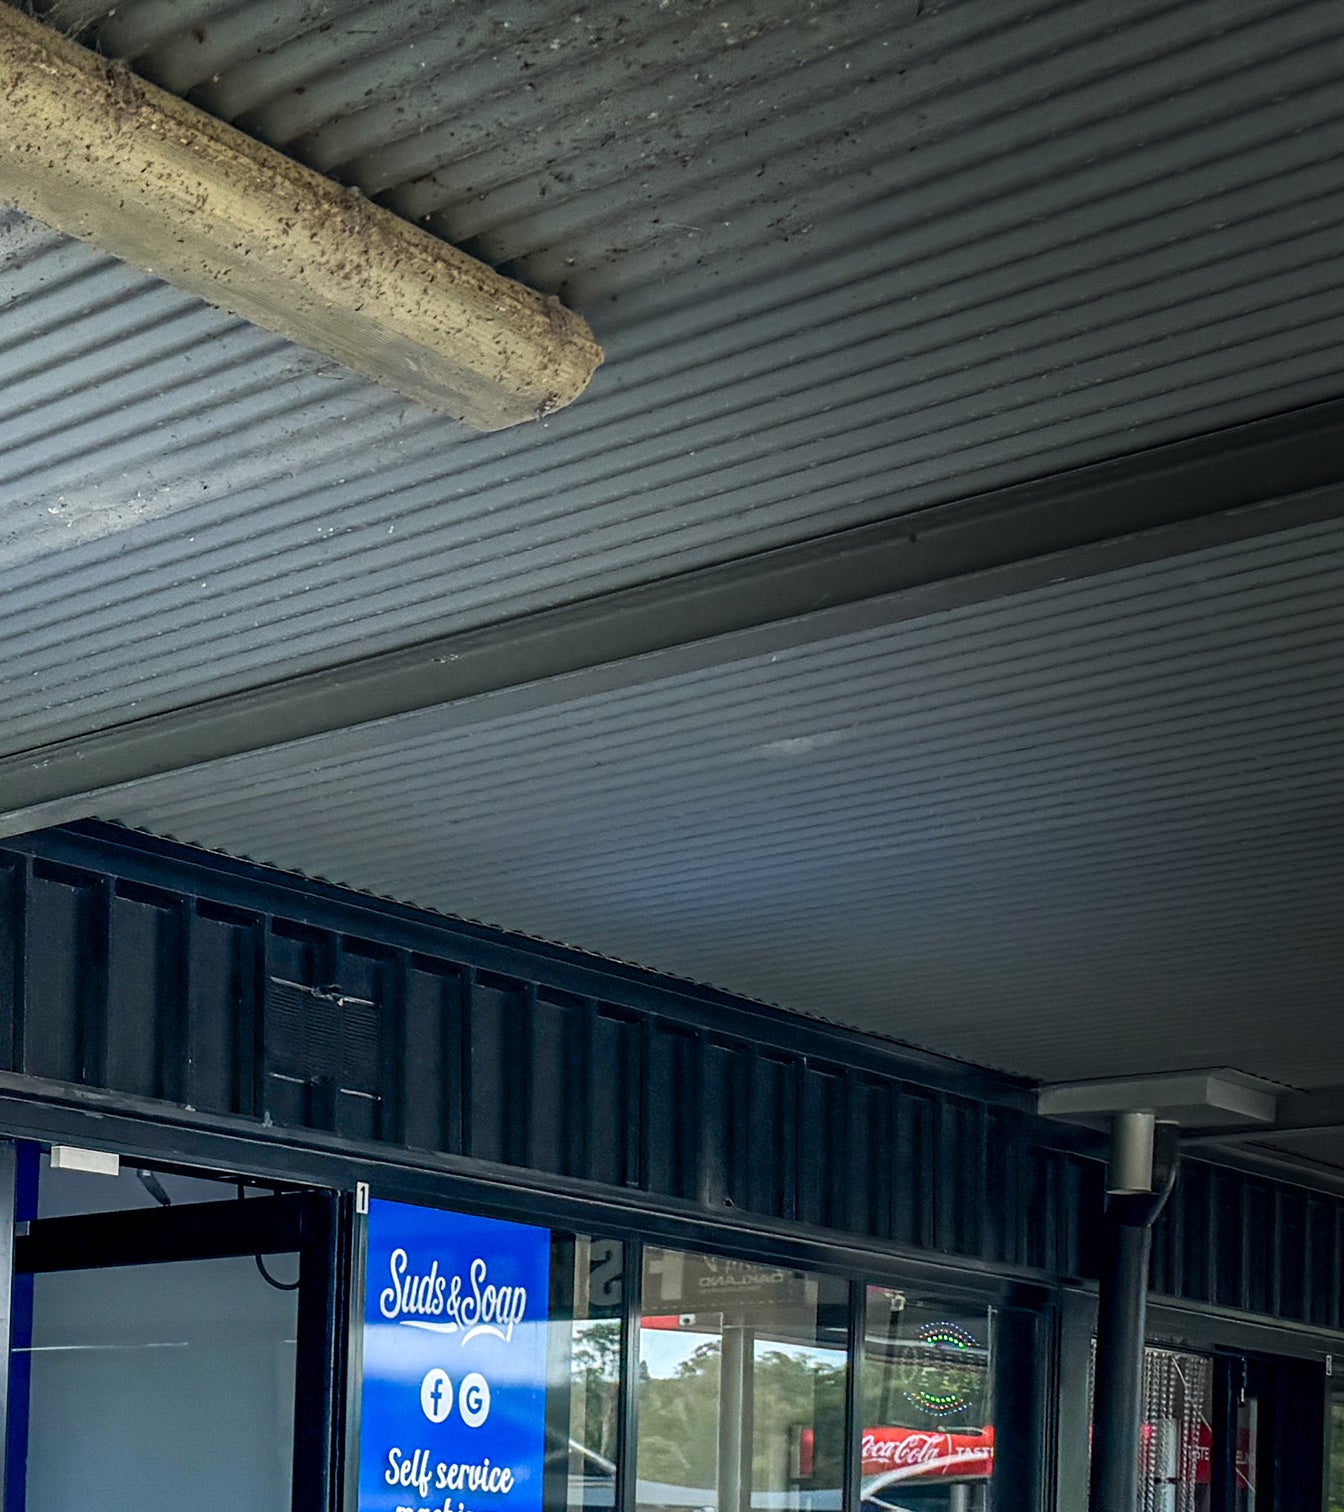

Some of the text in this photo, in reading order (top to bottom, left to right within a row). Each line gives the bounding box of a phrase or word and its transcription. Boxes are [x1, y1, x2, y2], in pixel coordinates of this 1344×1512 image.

[379, 1248, 445, 1320] Suds
[447, 1275, 464, 1331] &
[461, 1258, 526, 1342] Soap
[385, 1447, 514, 1498] Self service
